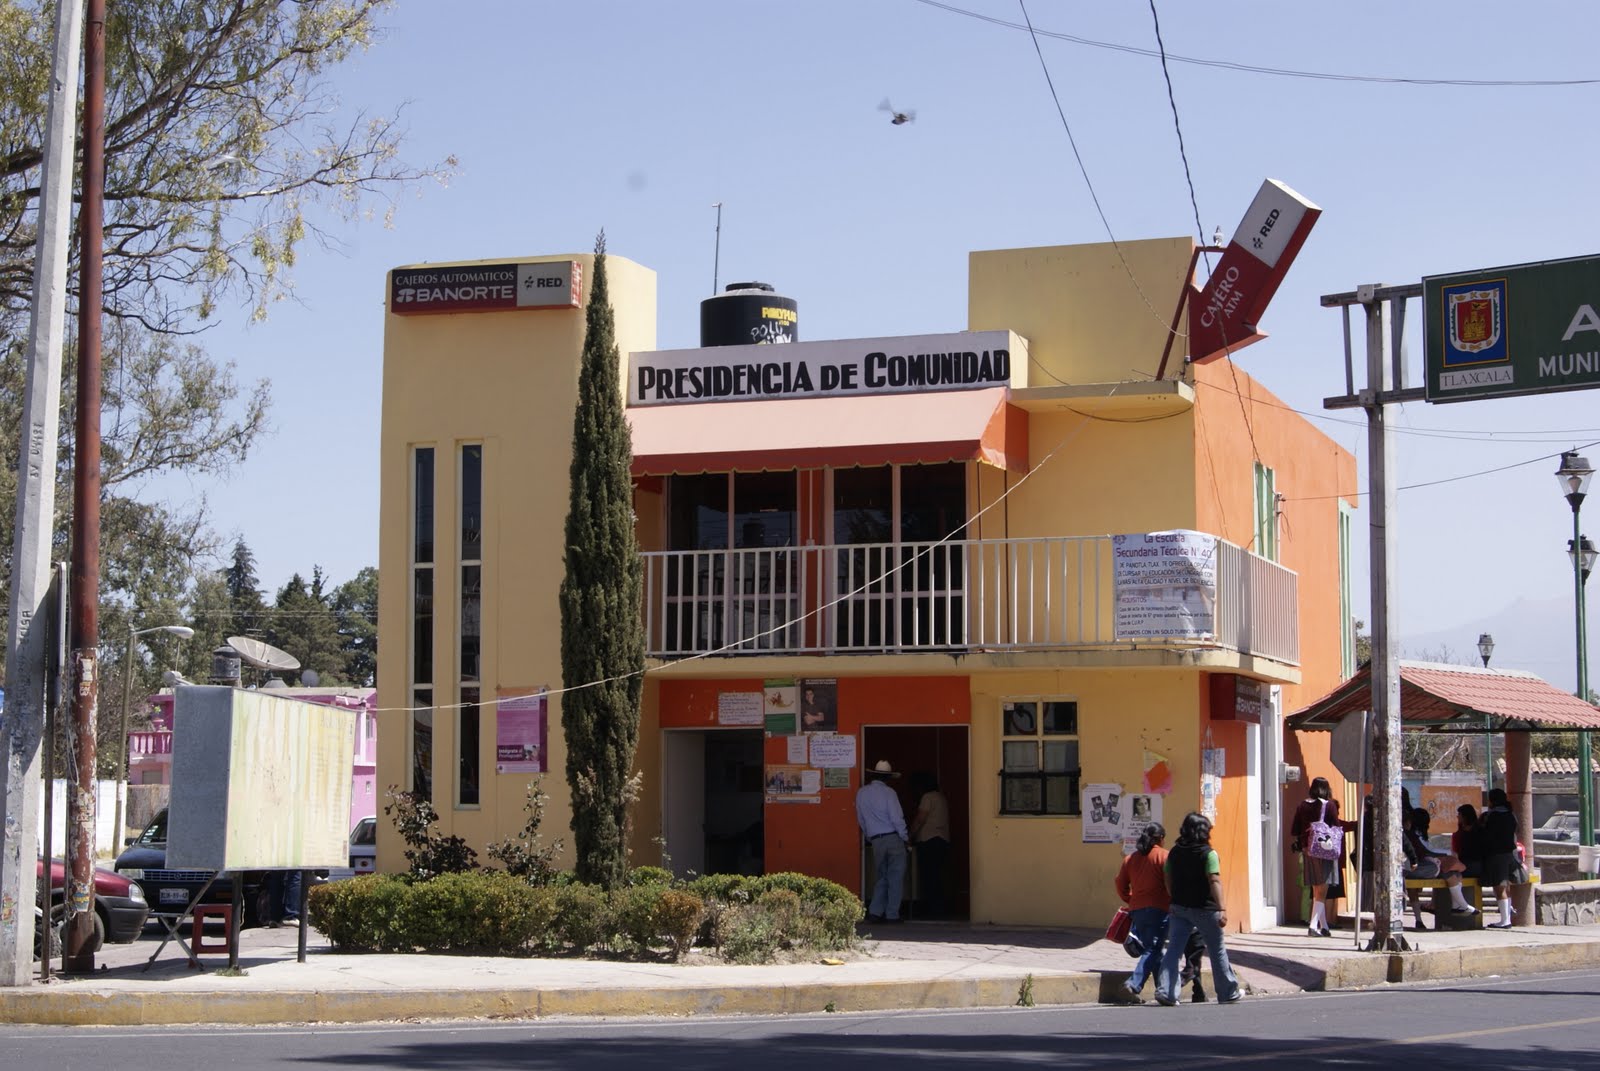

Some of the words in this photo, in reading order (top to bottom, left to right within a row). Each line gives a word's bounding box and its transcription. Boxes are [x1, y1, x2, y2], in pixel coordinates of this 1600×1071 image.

[1260, 208, 1280, 237] RED
[396, 273, 438, 286] CAJEROS
[440, 271, 514, 283] AUTOMATICOS
[537, 278, 562, 288] RED
[416, 285, 514, 302] BANORTE
[1200, 266, 1239, 327] CAJERO
[1223, 291, 1244, 319] ATM
[638, 361, 814, 400] PRESIDENCIA
[820, 364, 858, 391] DE
[864, 349, 1011, 388] COMUNIDAD
[1442, 370, 1512, 387] TLAXCALA
[1116, 547, 1158, 558] Secundaria
[1160, 545, 1189, 557] Técnica
